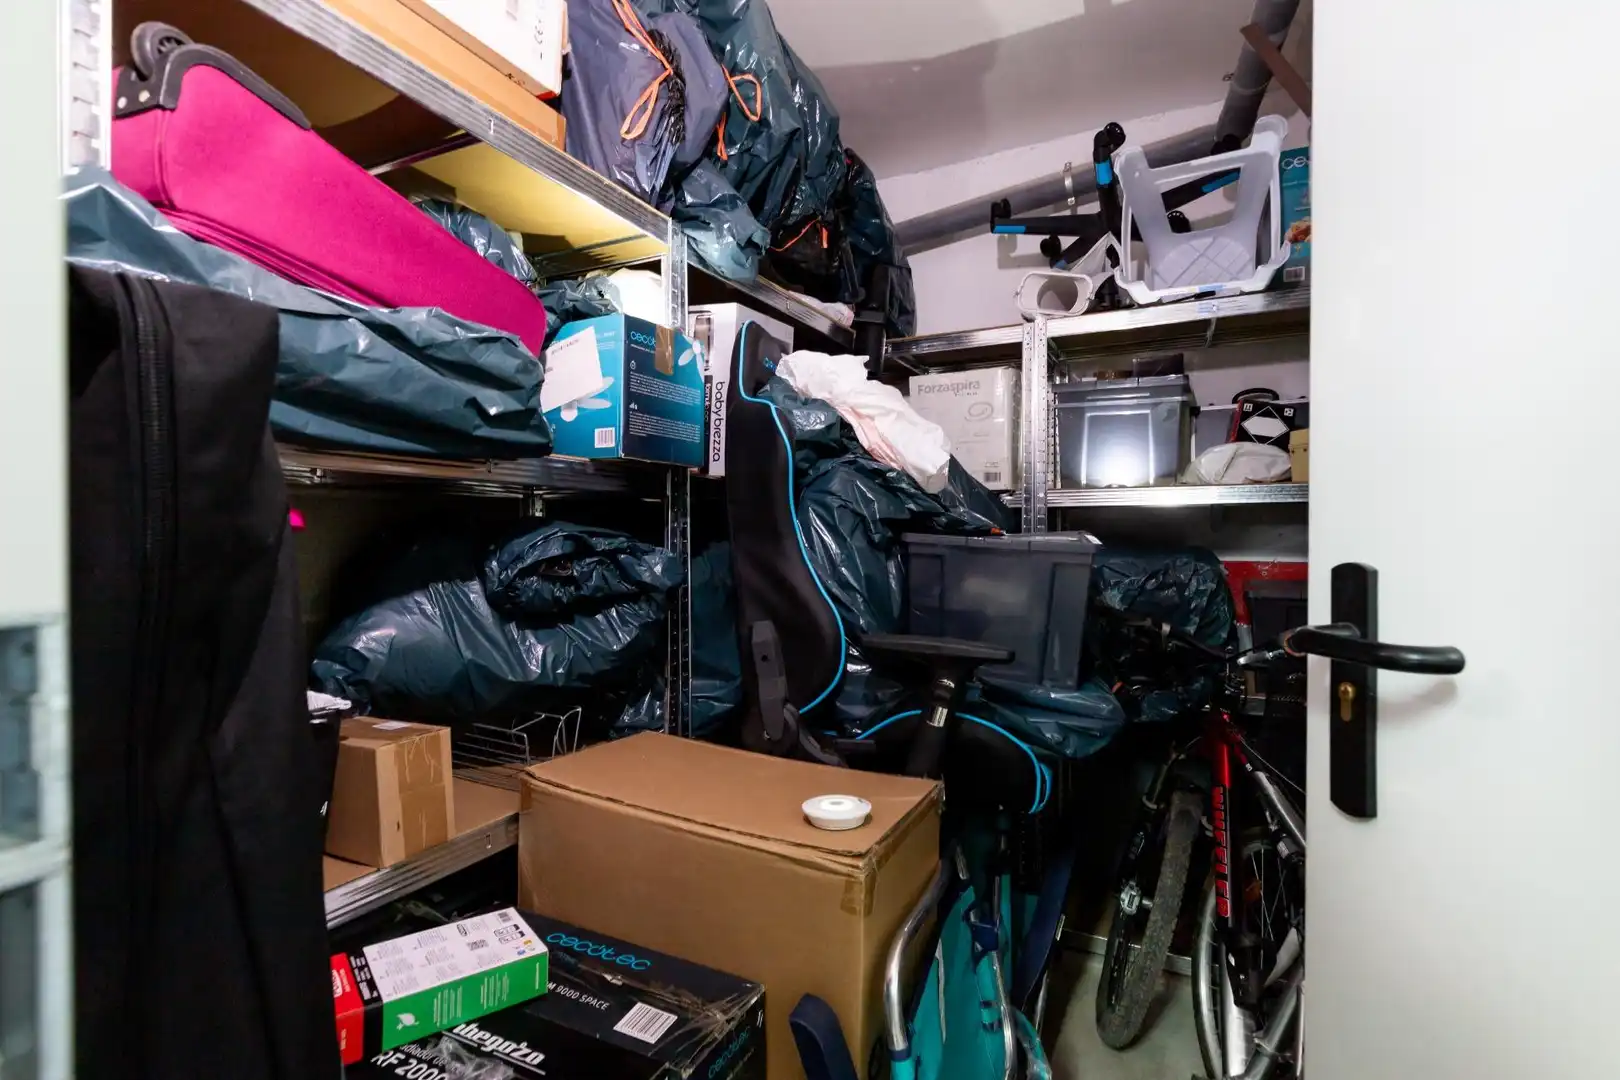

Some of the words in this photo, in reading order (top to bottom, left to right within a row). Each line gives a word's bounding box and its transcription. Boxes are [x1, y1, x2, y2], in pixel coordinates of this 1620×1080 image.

[917, 380, 981, 396] Forzaspira
[546, 932, 651, 970] cecotec
[557, 984, 580, 999] 9000
[579, 993, 610, 1011] SPACE
[370, 1050, 406, 1068] RF
